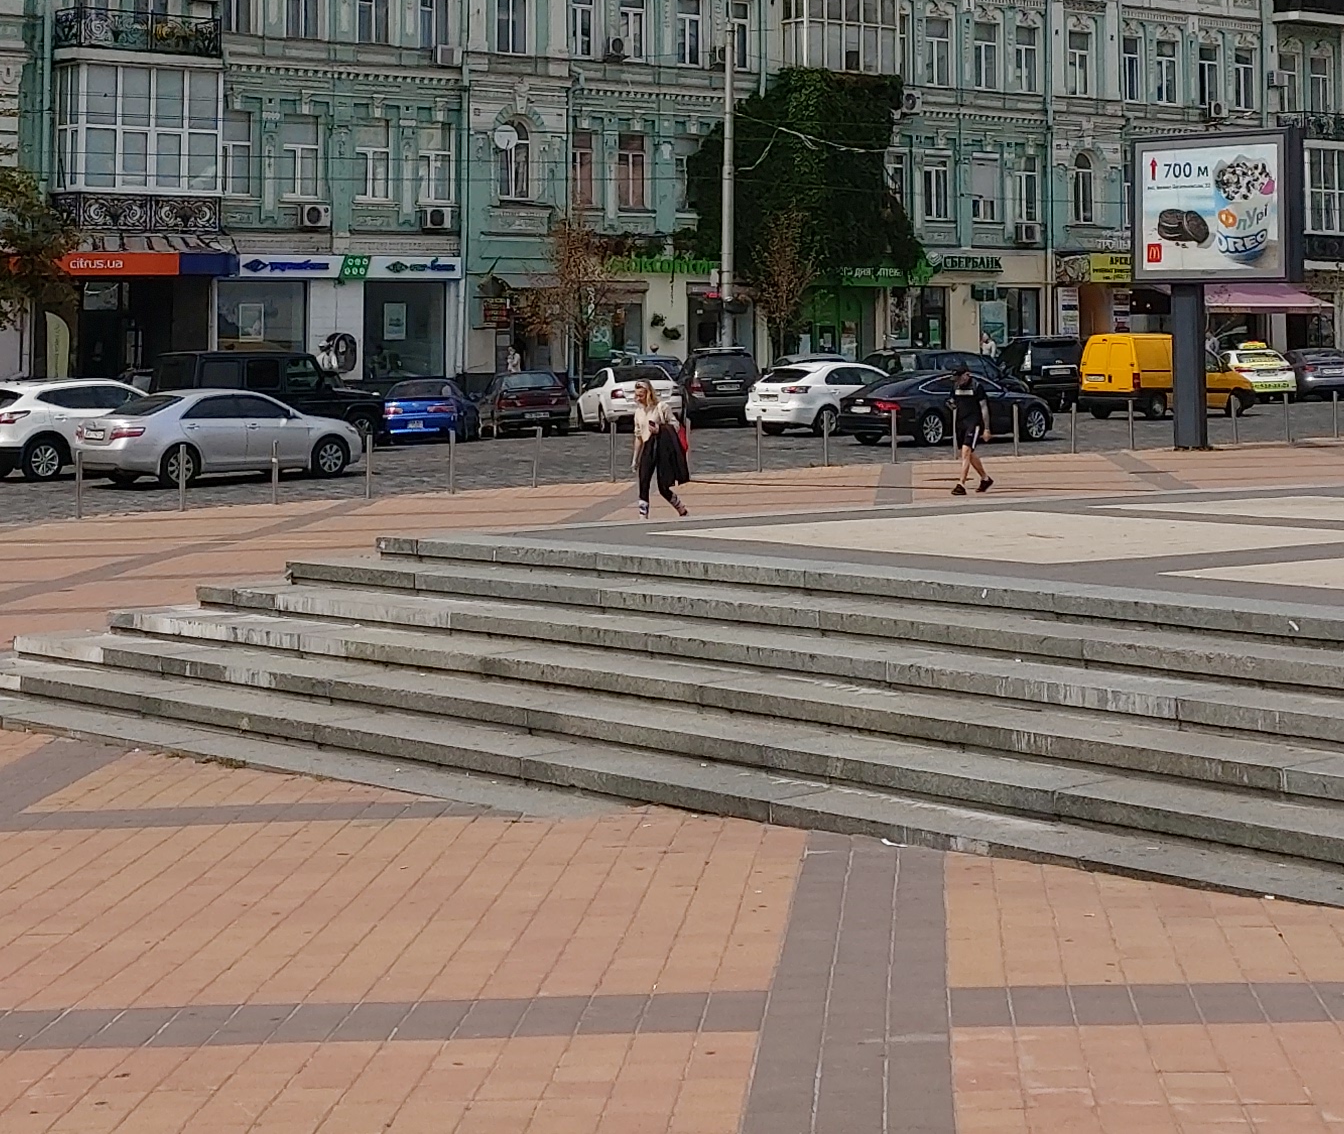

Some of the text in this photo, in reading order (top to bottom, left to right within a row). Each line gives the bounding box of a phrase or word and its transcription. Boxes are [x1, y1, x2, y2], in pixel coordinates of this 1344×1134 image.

[1163, 162, 1192, 178] 700
[1217, 228, 1268, 254] OREO
[69, 256, 125, 269] citrus.ua
[943, 255, 1003, 270] СБЕРБАНК
